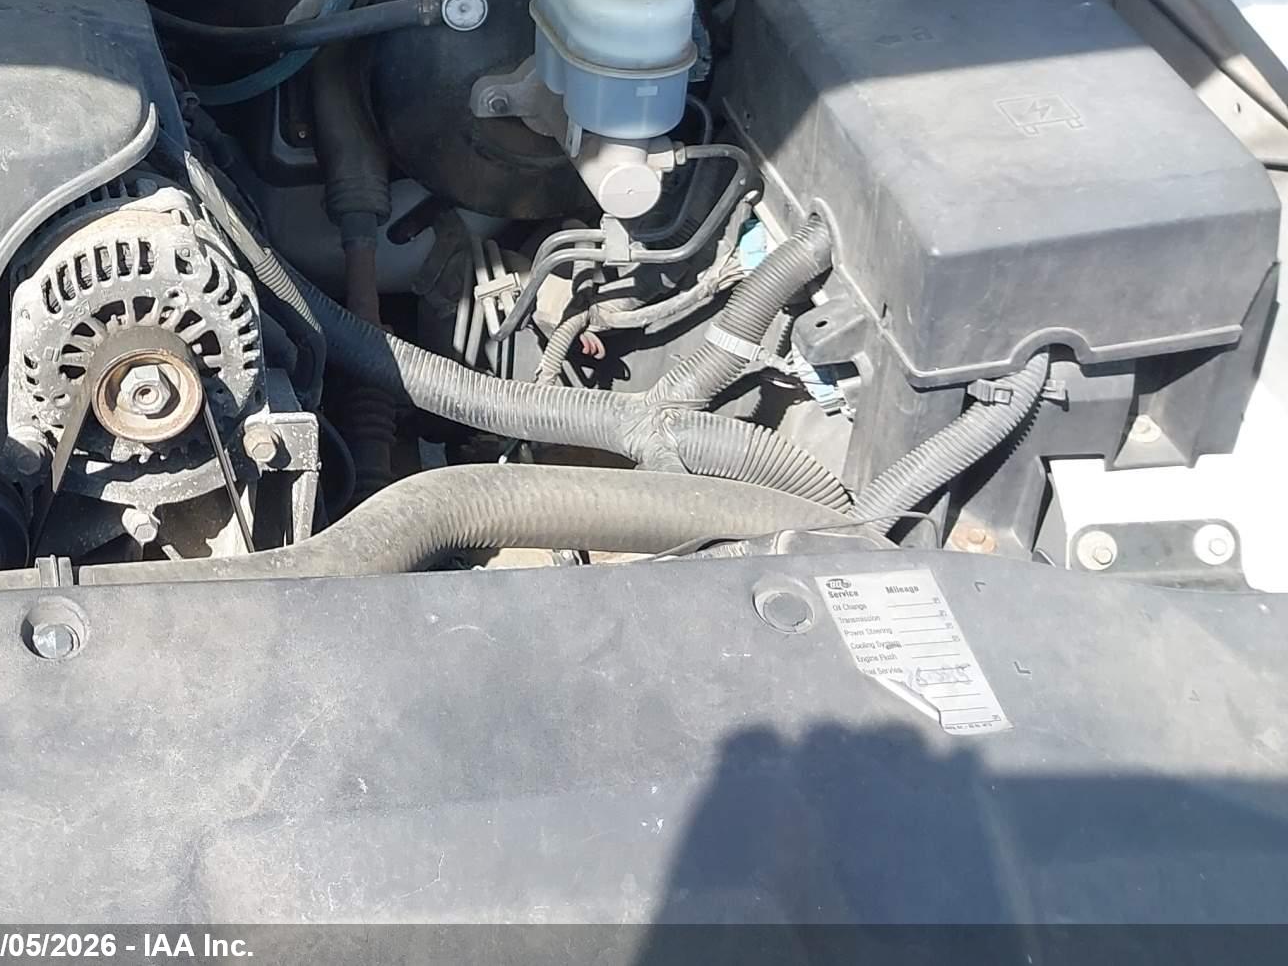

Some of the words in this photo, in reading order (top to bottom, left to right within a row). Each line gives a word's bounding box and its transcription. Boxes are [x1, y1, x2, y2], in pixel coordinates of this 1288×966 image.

[828, 590, 859, 599] Service
[885, 585, 920, 595] Mileage
[843, 603, 868, 611] Change
[839, 615, 881, 624] Transmission
[844, 629, 865, 637] Power
[866, 626, 893, 636] Steering
[850, 641, 876, 650] Cooling
[856, 654, 879, 664] Engine
